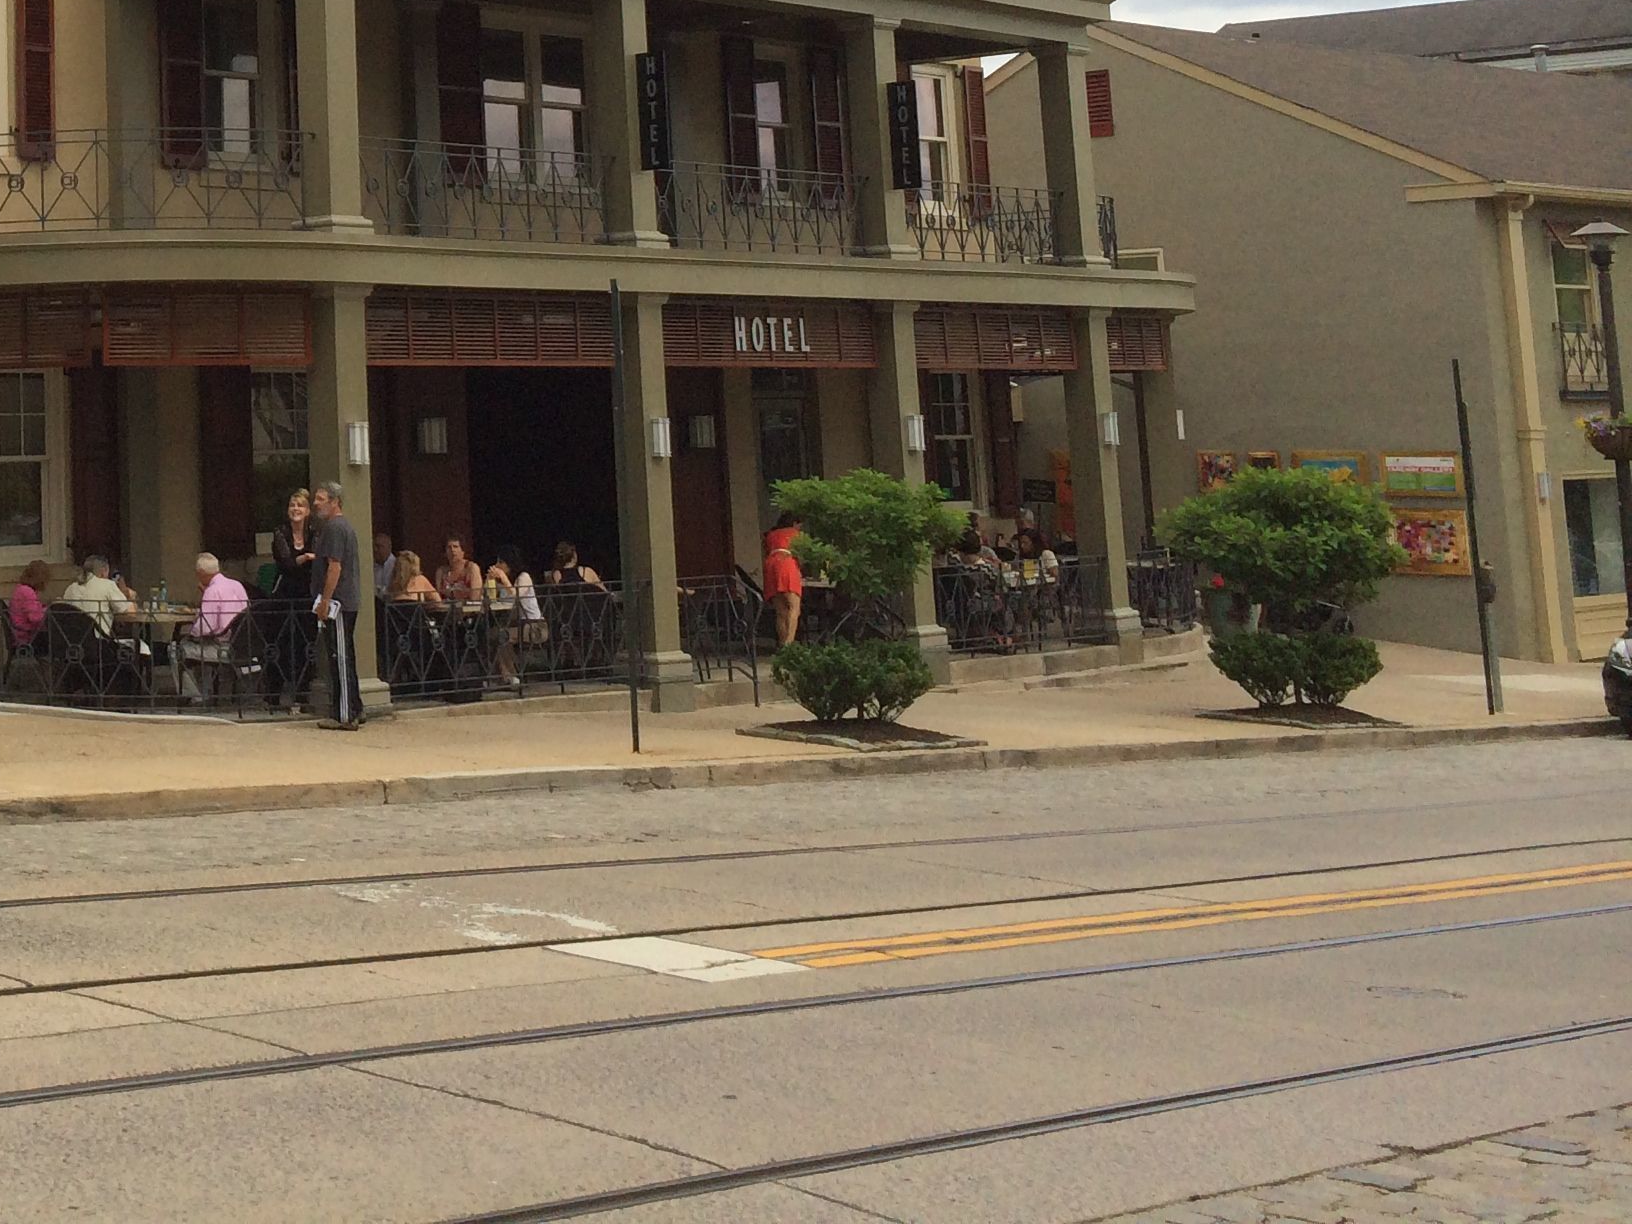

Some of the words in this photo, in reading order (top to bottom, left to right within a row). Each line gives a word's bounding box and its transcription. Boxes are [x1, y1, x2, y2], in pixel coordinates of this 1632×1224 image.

[645, 56, 660, 166] HOTEL
[896, 85, 912, 185] HOTEL
[734, 316, 811, 352] HOTEL
